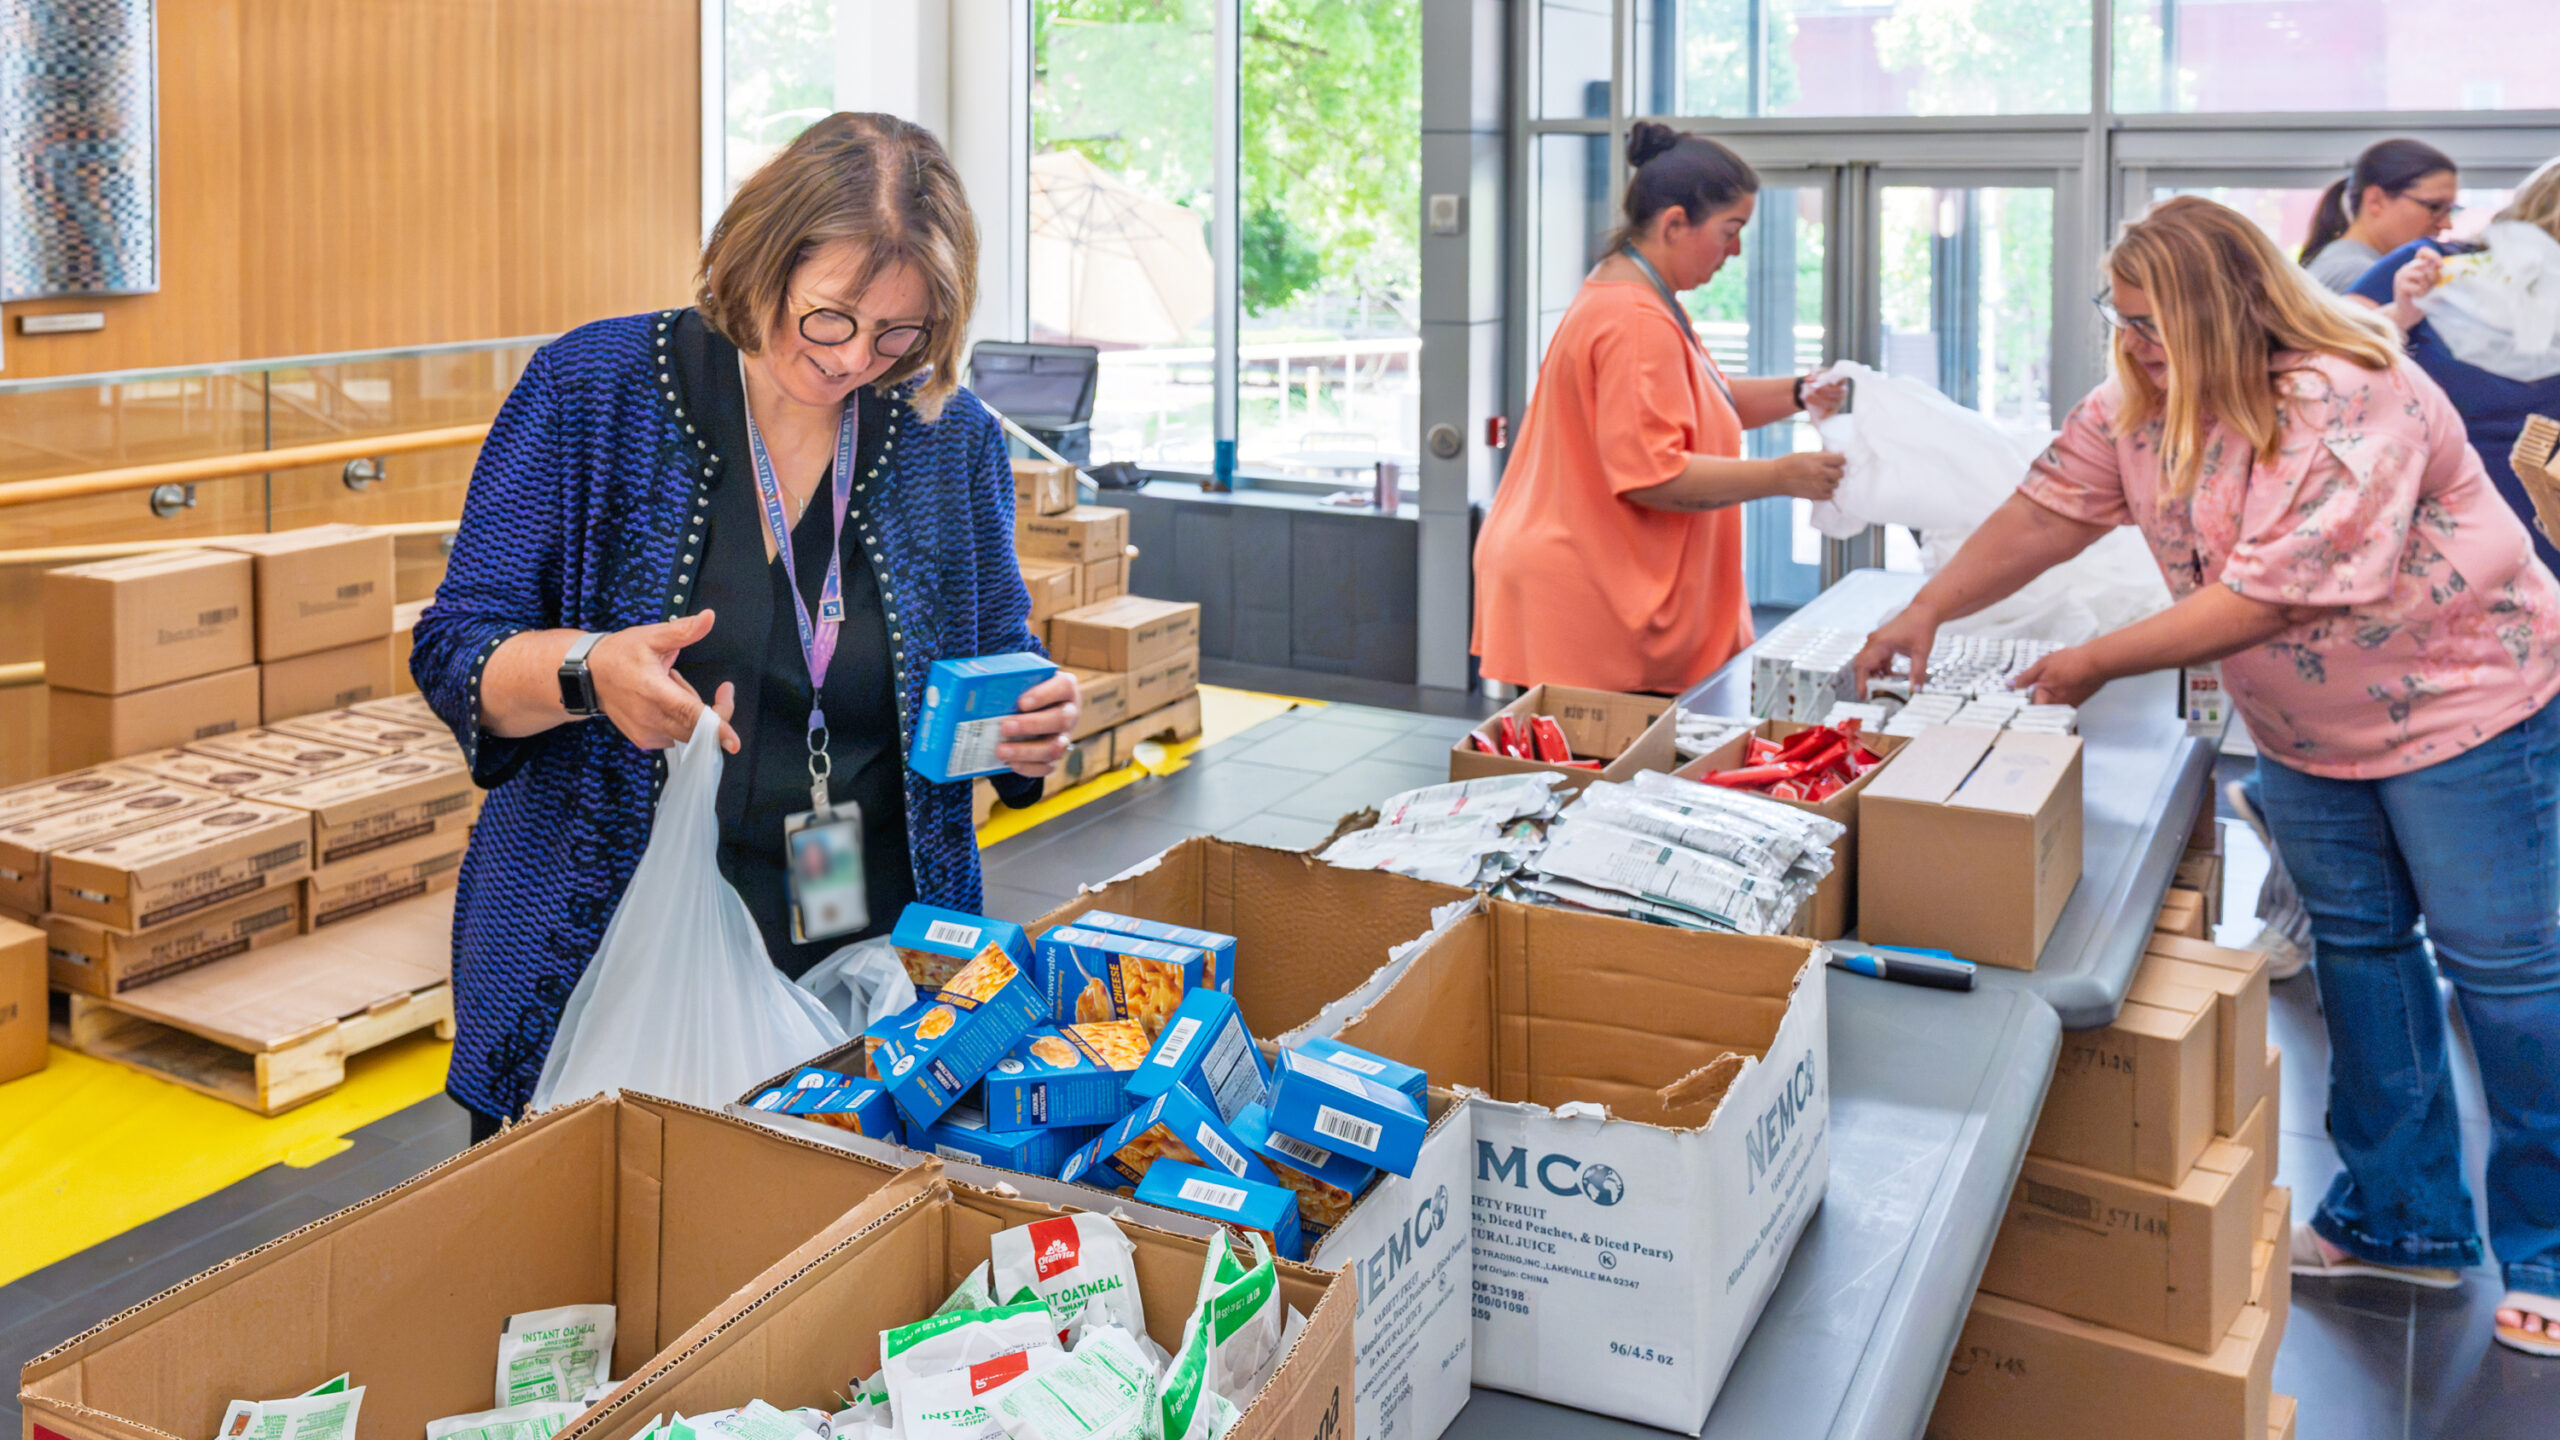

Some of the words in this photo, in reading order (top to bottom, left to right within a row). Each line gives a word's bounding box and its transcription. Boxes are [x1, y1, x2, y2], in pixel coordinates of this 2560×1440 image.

[757, 454, 778, 508] NATIONAL
[1109, 963, 1125, 1004] CHEESE
[1505, 1201, 1547, 1220] FRUIT
[1489, 1213, 1522, 1231] Diced
[1526, 1220, 1578, 1242] Peaches,
[1580, 1232, 1592, 1244] &
[1594, 1235, 1630, 1253] Diced
[1632, 1243, 1675, 1263] Pears)
[1516, 1234, 1556, 1255] JUICE
[1038, 1251, 1075, 1273] granvita
[1479, 1263, 1488, 1272] of
[1489, 1265, 1519, 1279] Origin:
[1520, 1272, 1549, 1285] CHINA
[1598, 1273, 1612, 1283] MA
[1613, 1277, 1640, 1290] 02347
[1061, 1274, 1124, 1303] OATMEAL
[522, 1328, 560, 1343] INSTANT
[1609, 1341, 1654, 1362] 96/4.5
[1656, 1353, 1674, 1366] oz
[540, 1383, 557, 1395] 130
